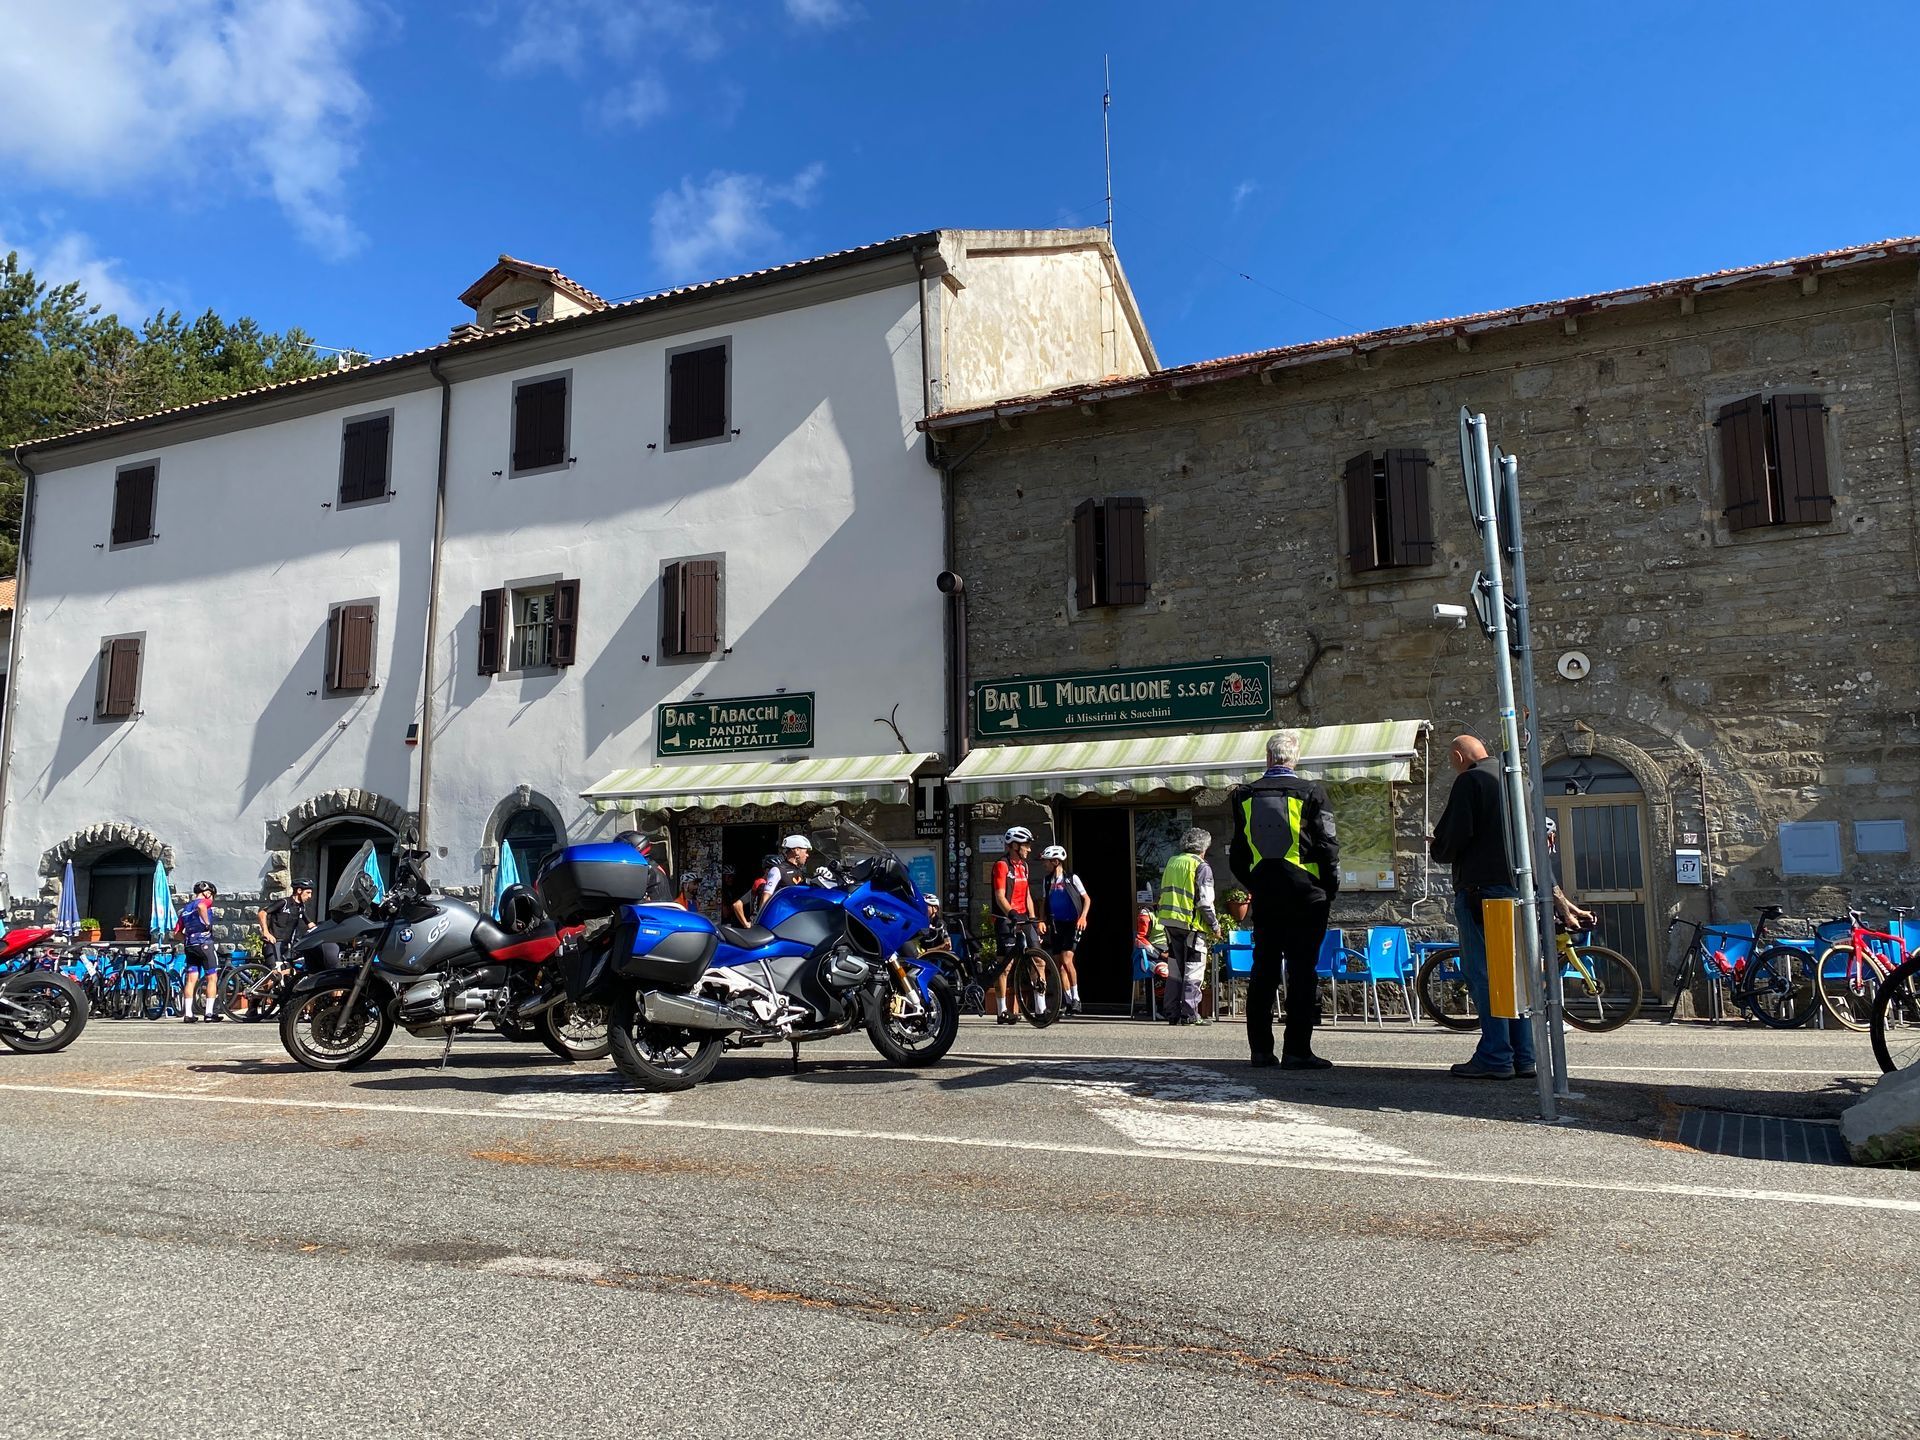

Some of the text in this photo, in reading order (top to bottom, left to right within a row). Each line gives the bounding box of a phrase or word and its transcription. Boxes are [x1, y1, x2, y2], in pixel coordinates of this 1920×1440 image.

[1220, 677, 1263, 694] MOKA
[1028, 684, 1049, 709] IL
[1177, 681, 1216, 698] S.S.67
[1221, 691, 1263, 707] ARRA
[708, 705, 779, 724] TABACCHI
[781, 712, 808, 725] MOKA
[1065, 706, 1171, 724] di Missirini & Sacchini
[709, 724, 758, 737] PANINI
[781, 723, 808, 734] ARRA
[689, 733, 779, 749] PRIMI PIATTI
[918, 777, 942, 820] T
[1682, 863, 1696, 873] 87
[427, 915, 451, 943] GS
